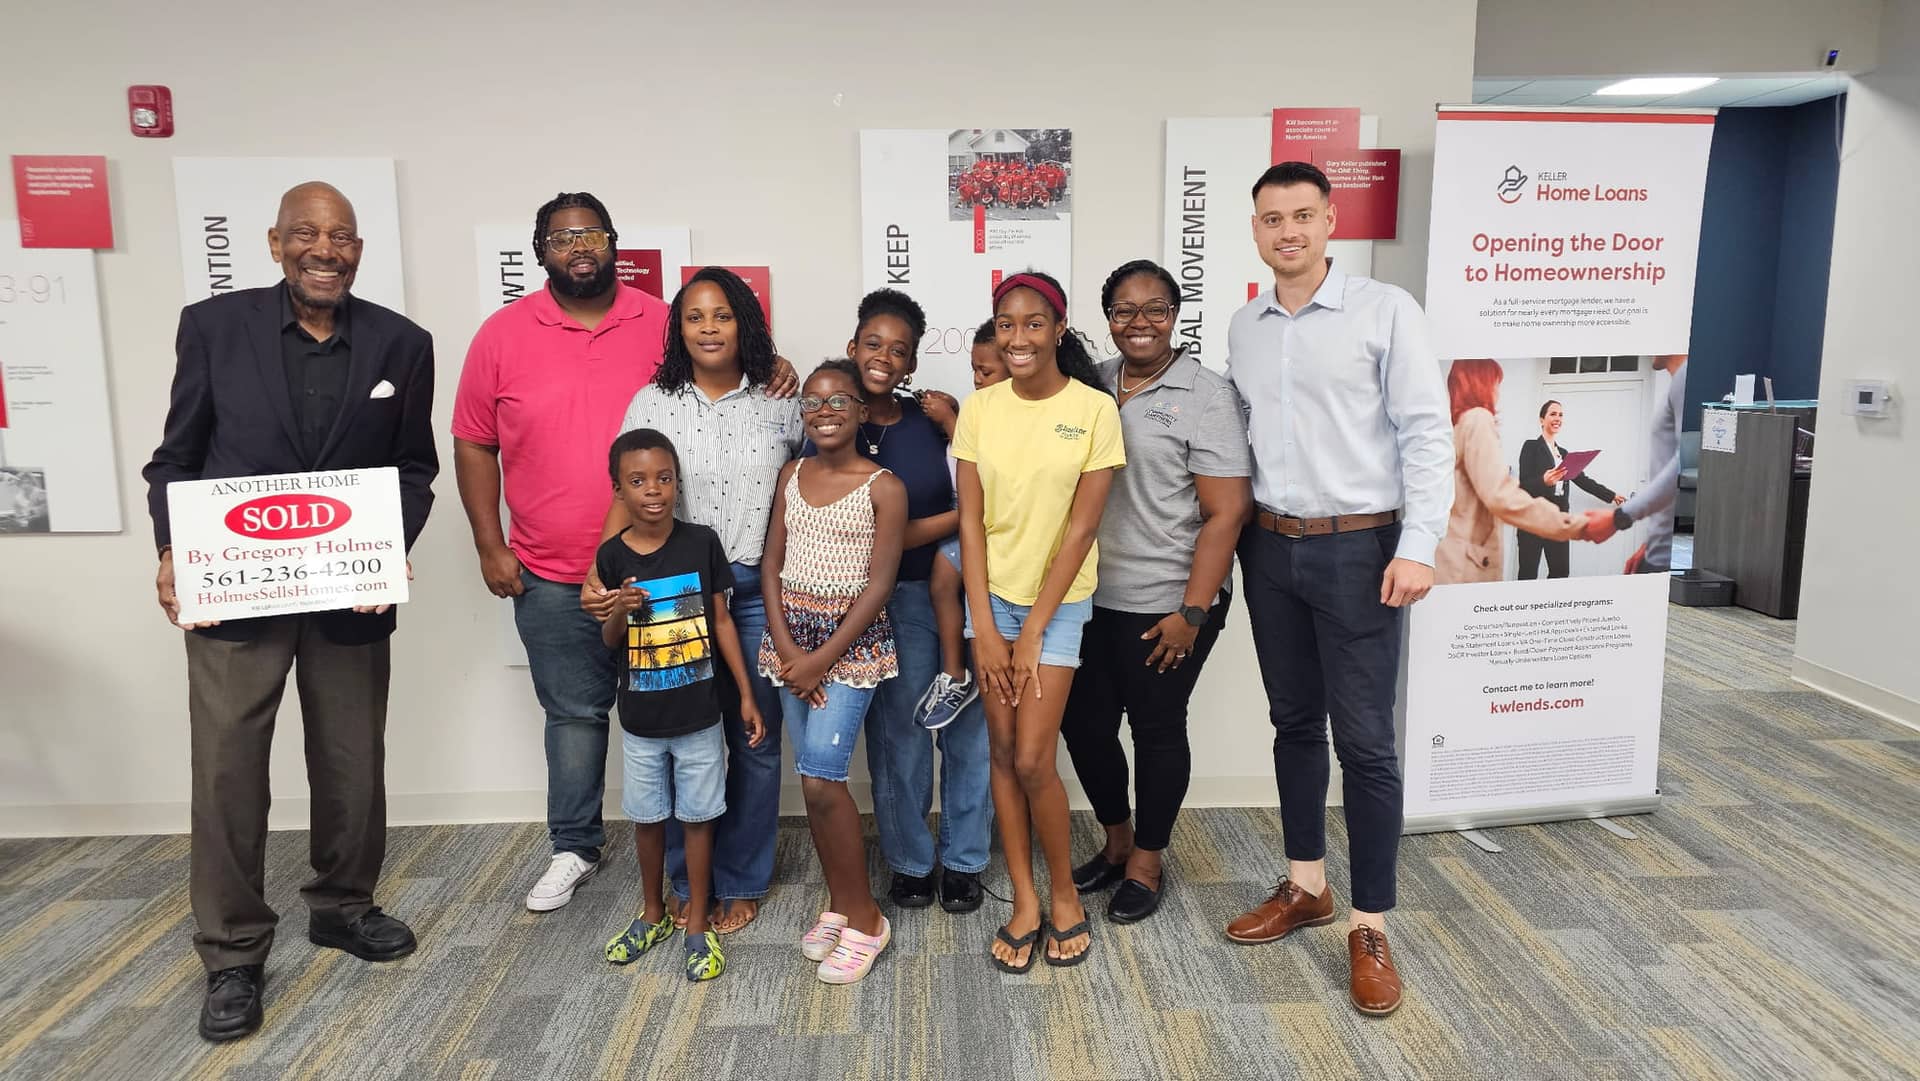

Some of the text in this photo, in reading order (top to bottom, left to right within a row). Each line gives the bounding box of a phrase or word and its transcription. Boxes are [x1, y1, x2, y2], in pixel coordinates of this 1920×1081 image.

[1537, 172, 1568, 182] KELLER
[1537, 184, 1648, 202] Home Loans
[1181, 166, 1207, 302] MOVEMENT
[886, 223, 911, 284] KEEP
[1472, 233, 1664, 257] Opening the Door
[1465, 262, 1666, 286] to Homeownership
[1479, 309, 1507, 317] solution
[1507, 308, 1518, 316] for
[1518, 308, 1539, 318] nearly
[1540, 309, 1560, 318] every
[1560, 309, 1593, 317] mortgage
[1612, 307, 1627, 315] Our
[1547, 298, 1580, 307] mortgage
[1494, 320, 1501, 328] to
[1502, 320, 1521, 328] make
[1521, 320, 1541, 328] home
[1542, 319, 1577, 328] ownership
[869, 444, 879, 455] S
[211, 474, 361, 496] ANOTHER HOME
[242, 503, 336, 533] SOLD
[187, 538, 393, 567] By Gregory Holmes
[202, 558, 382, 589] 561-236-4200
[197, 579, 388, 605] HolmesSellsHomes.com
[1473, 598, 1614, 613] Check out our specialized programs:
[1482, 678, 1595, 694] Contact me to learn more!
[1490, 696, 1585, 714] kwlends.com
